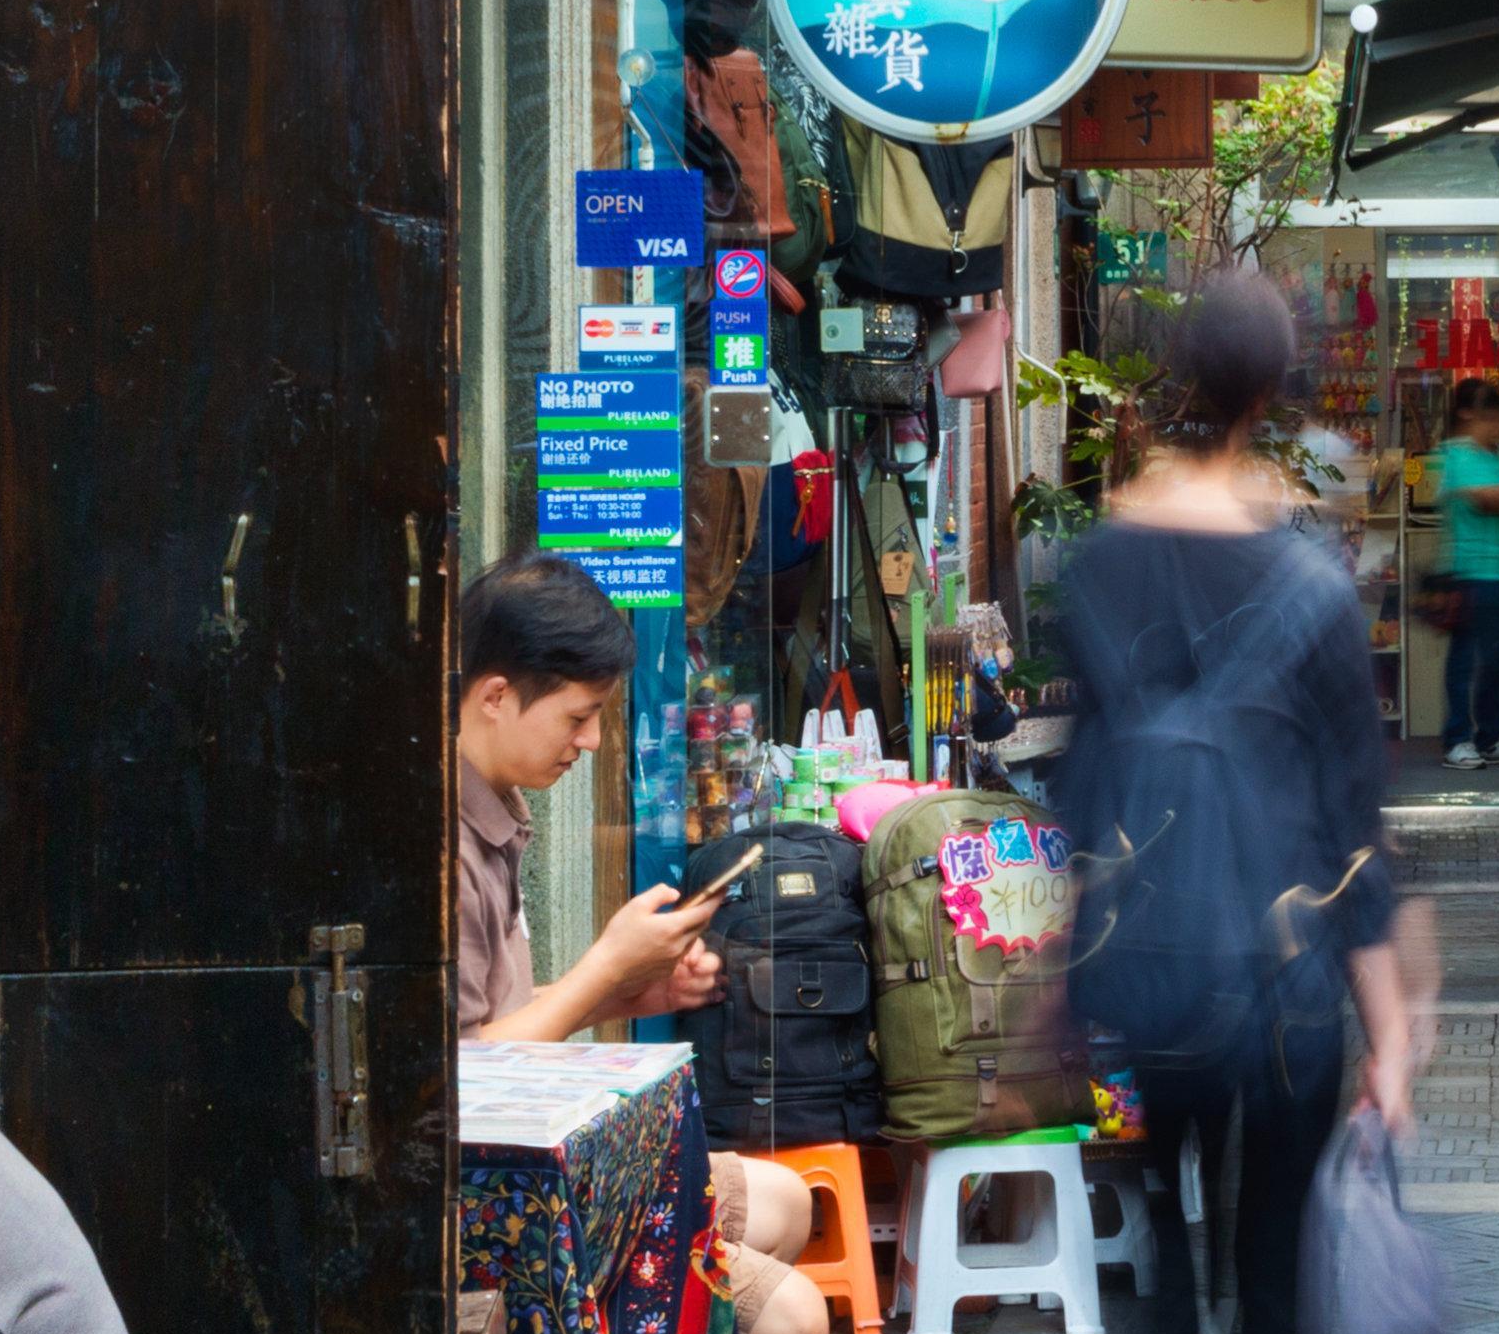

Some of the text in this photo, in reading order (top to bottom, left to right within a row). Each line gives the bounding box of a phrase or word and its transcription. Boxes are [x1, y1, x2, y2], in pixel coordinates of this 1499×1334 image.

[585, 194, 644, 214] OPEN
[636, 238, 688, 257] VISA
[715, 312, 751, 325] PUSH
[723, 336, 756, 368] 推
[604, 354, 653, 364] PURELAND
[721, 370, 757, 383] Push
[607, 411, 671, 421] PURELAND
[540, 436, 629, 452] Fixed Price
[541, 452, 592, 466] 谢绝还价
[608, 468, 671, 479] PURELAND
[547, 503, 562, 512] Fri
[548, 512, 563, 520] Sun
[609, 527, 672, 538] PURELAND
[579, 556, 677, 566] Video Surveillance
[609, 590, 671, 600] PURELAND
